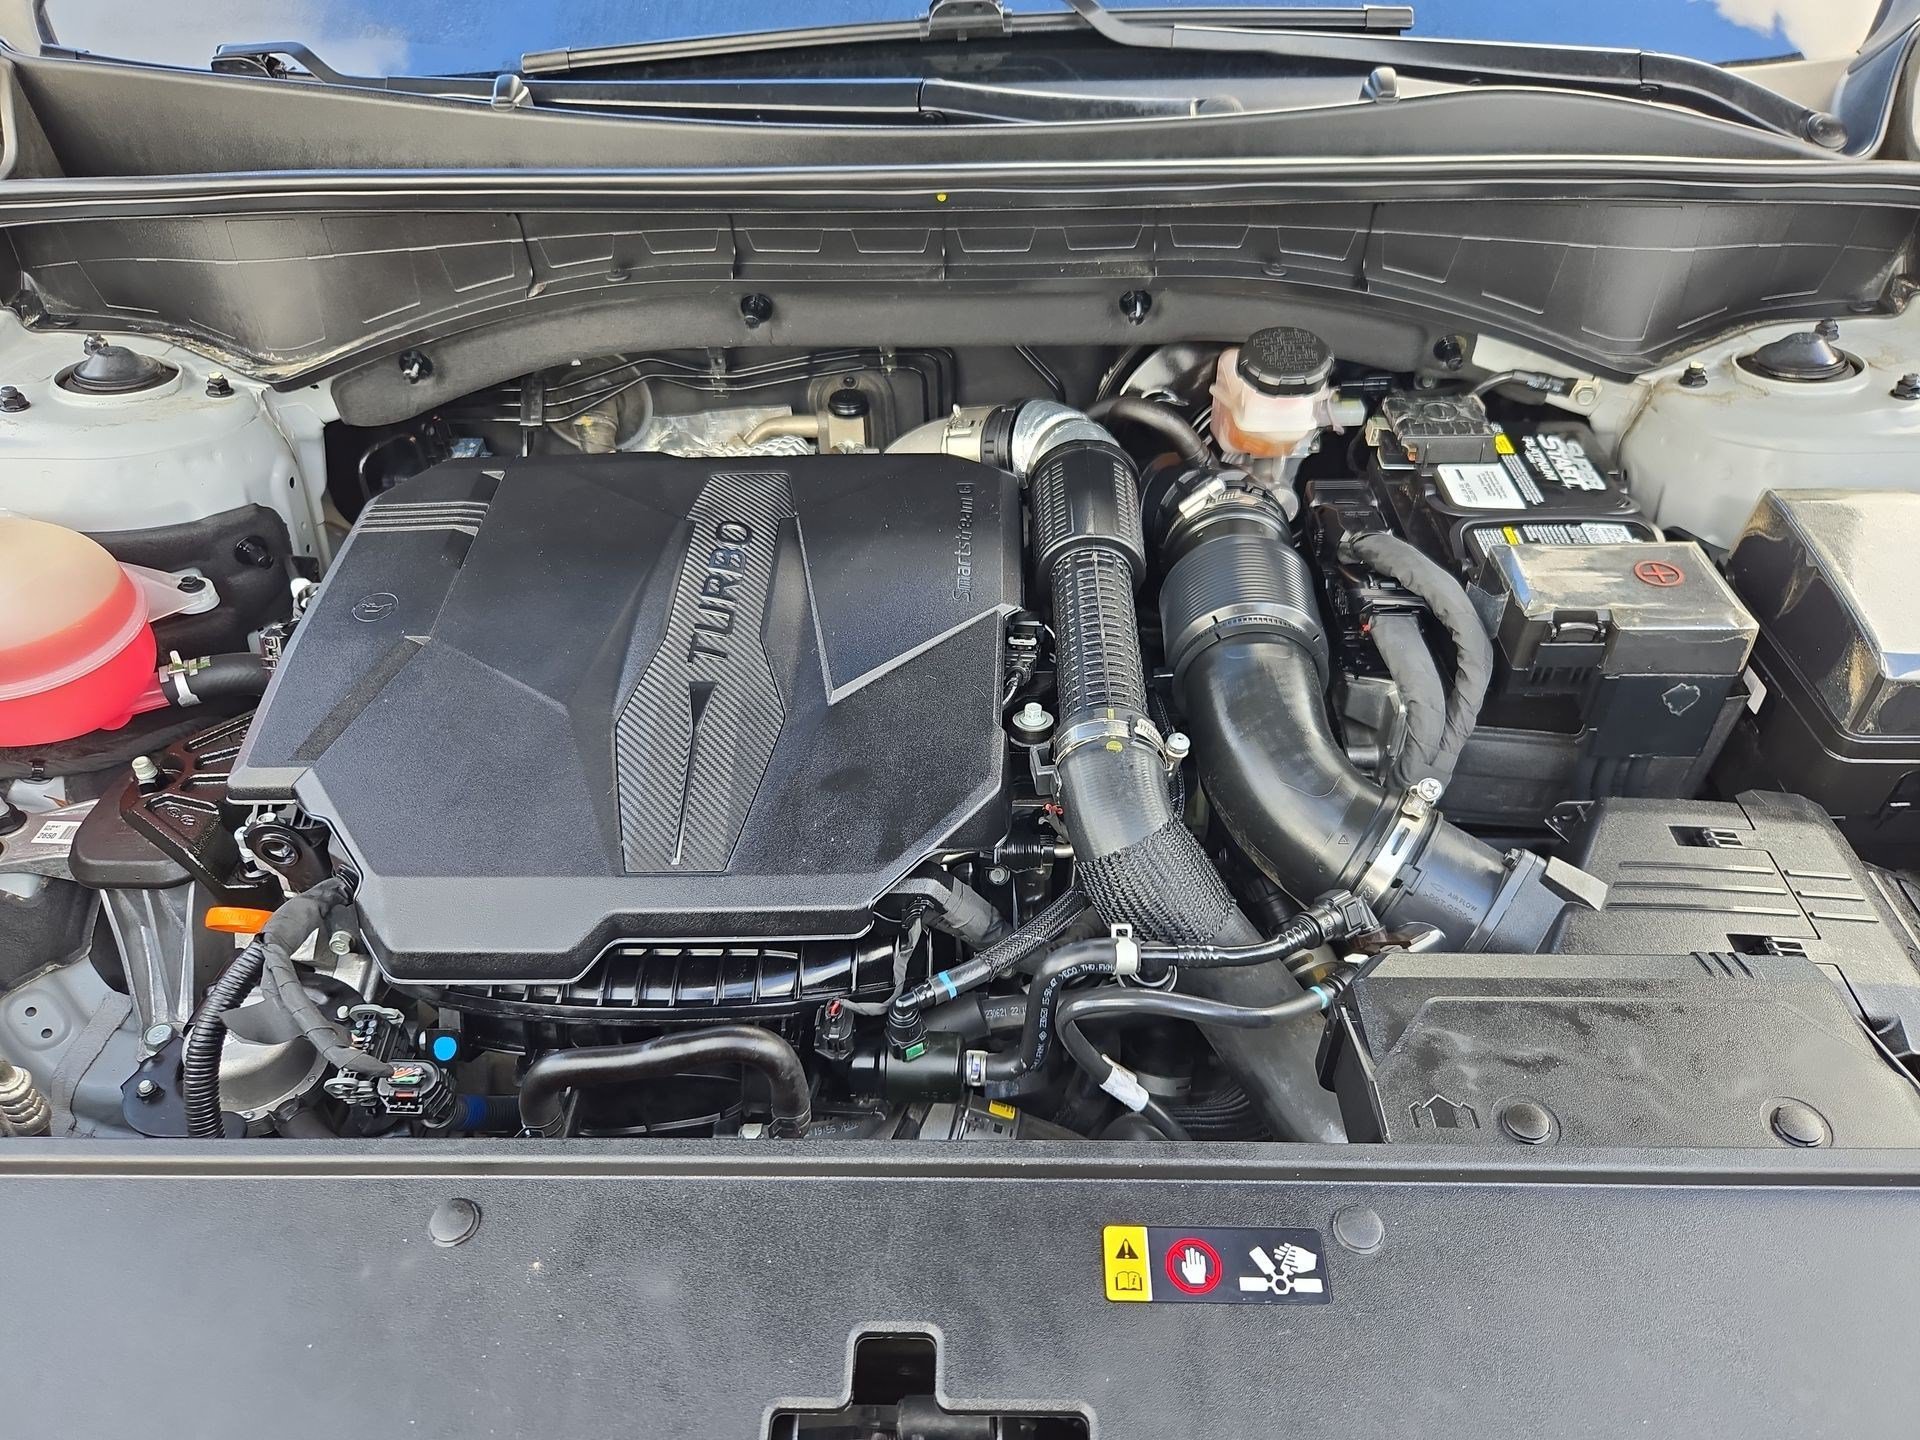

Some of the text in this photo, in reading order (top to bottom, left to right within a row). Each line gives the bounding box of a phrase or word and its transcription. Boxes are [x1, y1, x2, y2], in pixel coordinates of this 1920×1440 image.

[1537, 433, 1589, 491] START
[687, 520, 752, 663] TURBO
[952, 496, 973, 602] Smartstream
